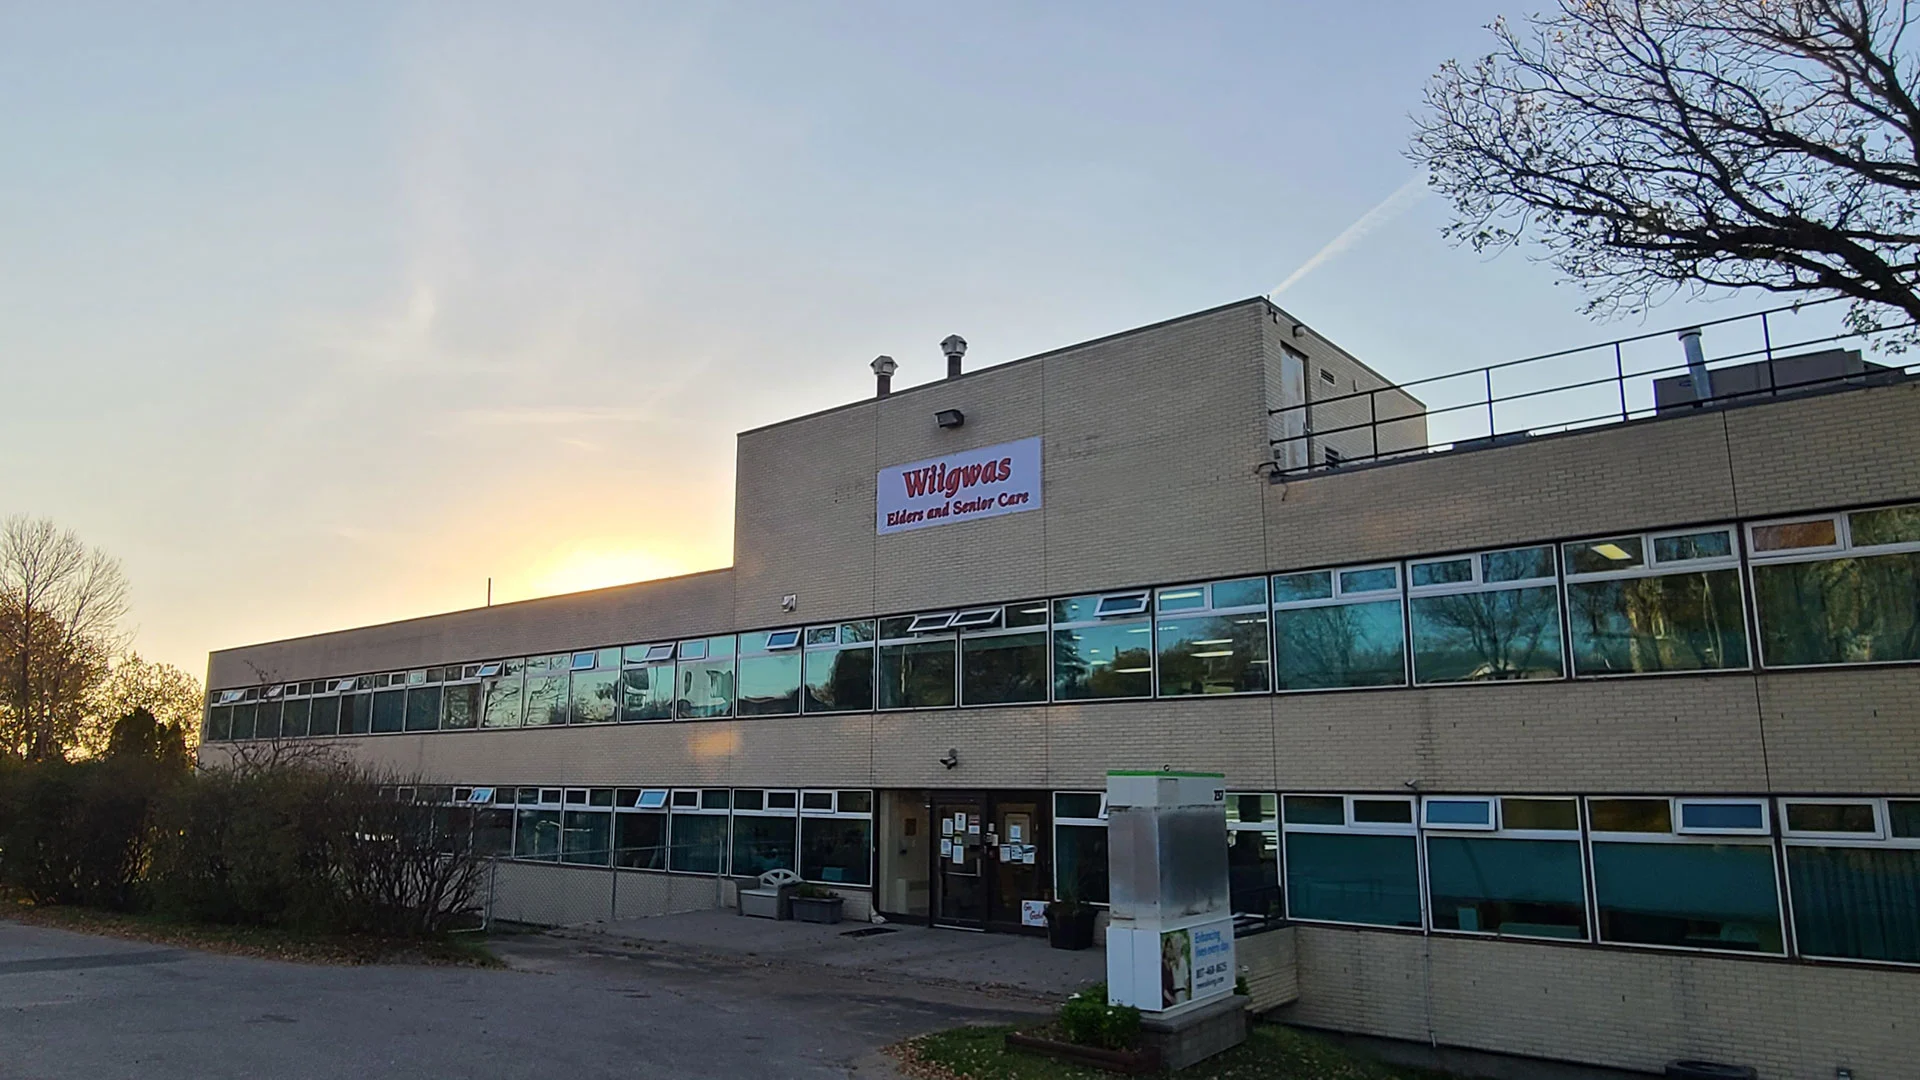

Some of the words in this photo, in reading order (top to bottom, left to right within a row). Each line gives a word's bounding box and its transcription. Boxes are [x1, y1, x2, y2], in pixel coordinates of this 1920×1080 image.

[902, 457, 1012, 498] Wiigwas
[887, 509, 924, 527] Elders
[927, 502, 950, 520] and
[953, 495, 995, 515] Senior
[997, 491, 1029, 508] Care
